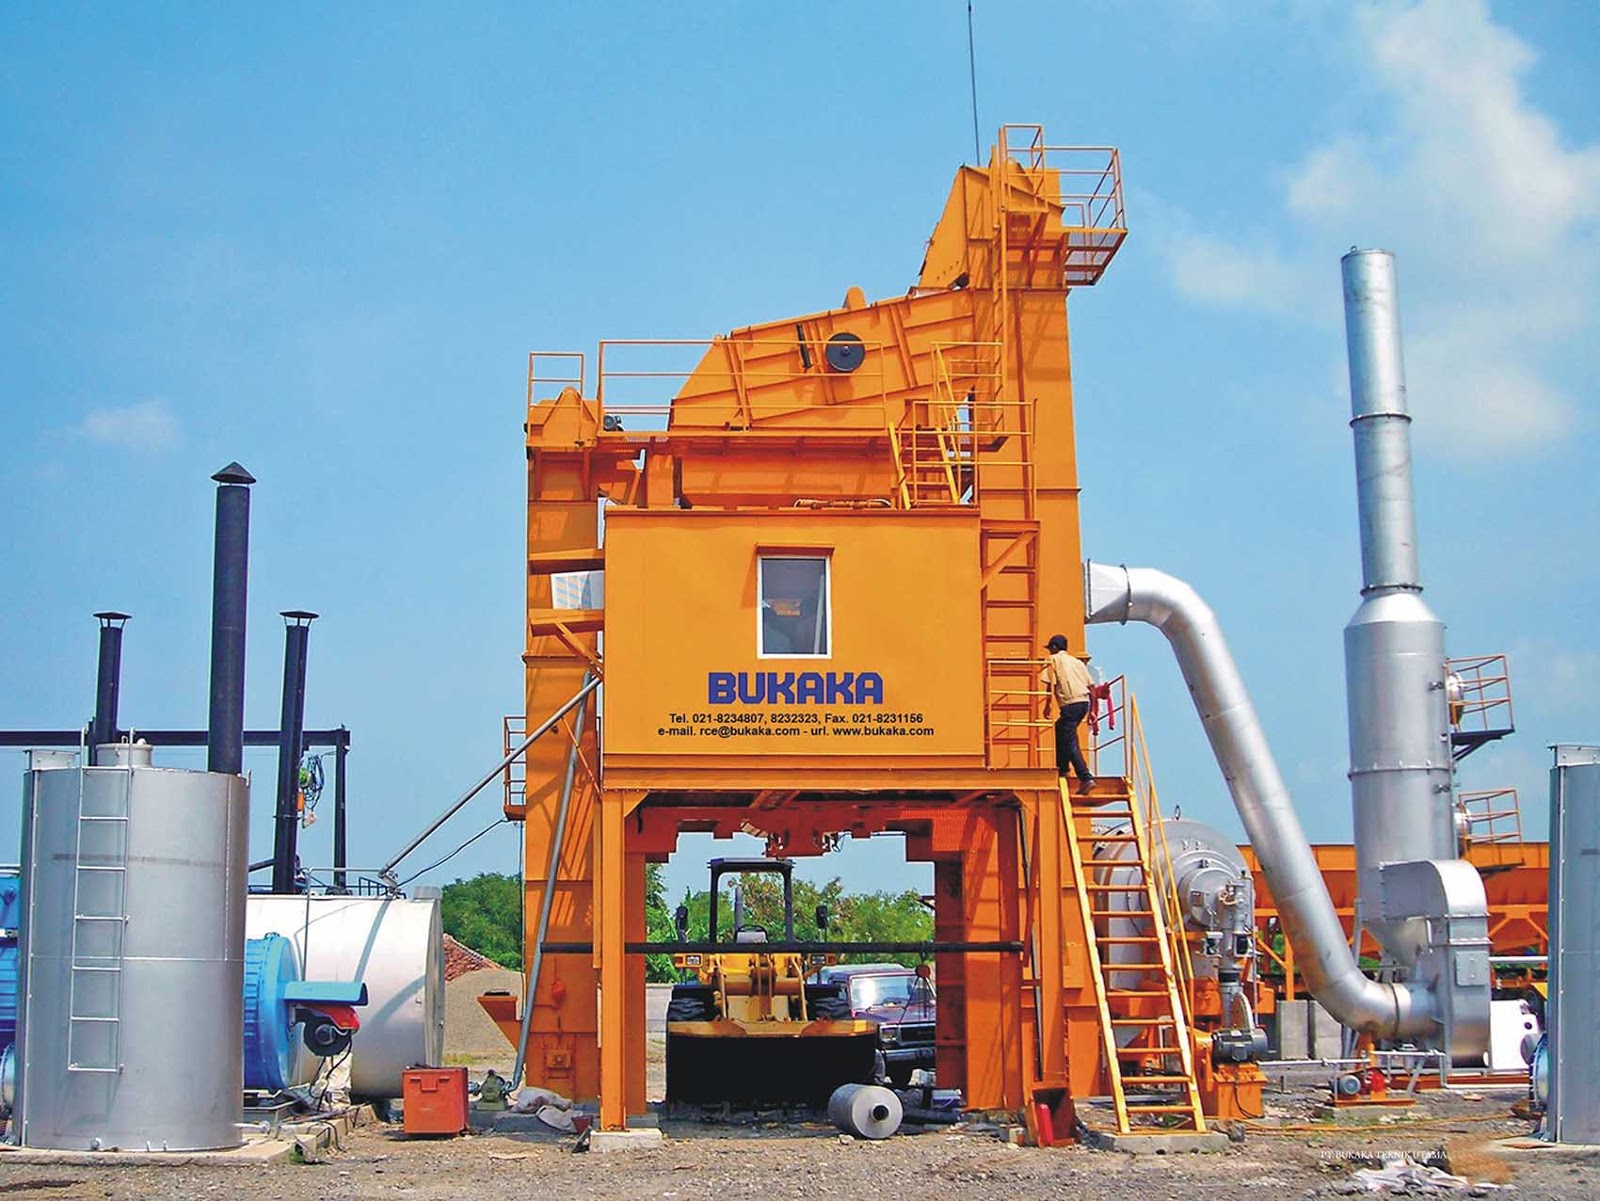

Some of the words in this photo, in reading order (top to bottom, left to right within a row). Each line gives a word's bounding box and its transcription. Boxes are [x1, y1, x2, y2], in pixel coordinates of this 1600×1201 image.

[708, 672, 883, 704] BUKAKA
[669, 713, 689, 724] Tel.
[692, 713, 768, 726] 021-8234807,
[770, 713, 821, 725] 8232323,
[824, 713, 849, 724] Fax.
[852, 713, 924, 724] 021-8231156
[657, 726, 696, 736] e-mail.
[699, 725, 800, 739] rce@bukaka.com
[810, 726, 829, 736] url.
[832, 726, 935, 736] www.bukaka.com
